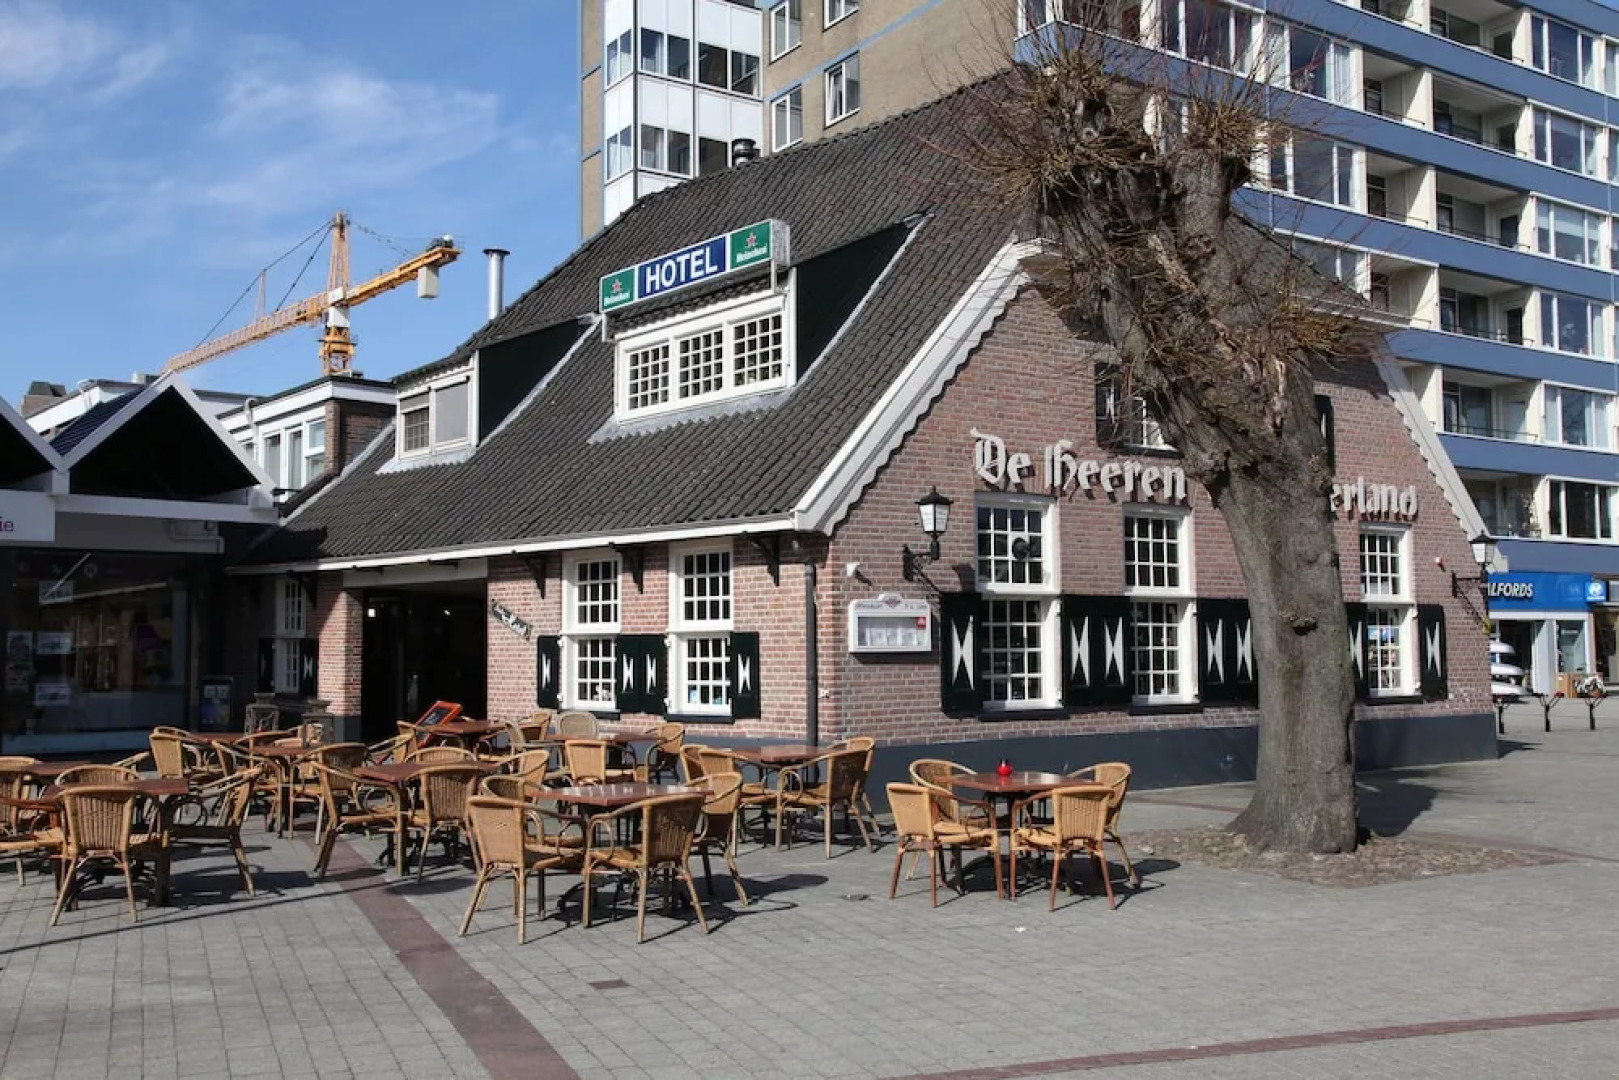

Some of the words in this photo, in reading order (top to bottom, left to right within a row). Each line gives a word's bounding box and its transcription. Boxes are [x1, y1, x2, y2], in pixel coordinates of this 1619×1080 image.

[645, 246, 718, 294] HOTEL
[969, 427, 1033, 484] De
[1044, 438, 1186, 500] Heeren
[1330, 475, 1418, 516] erland
